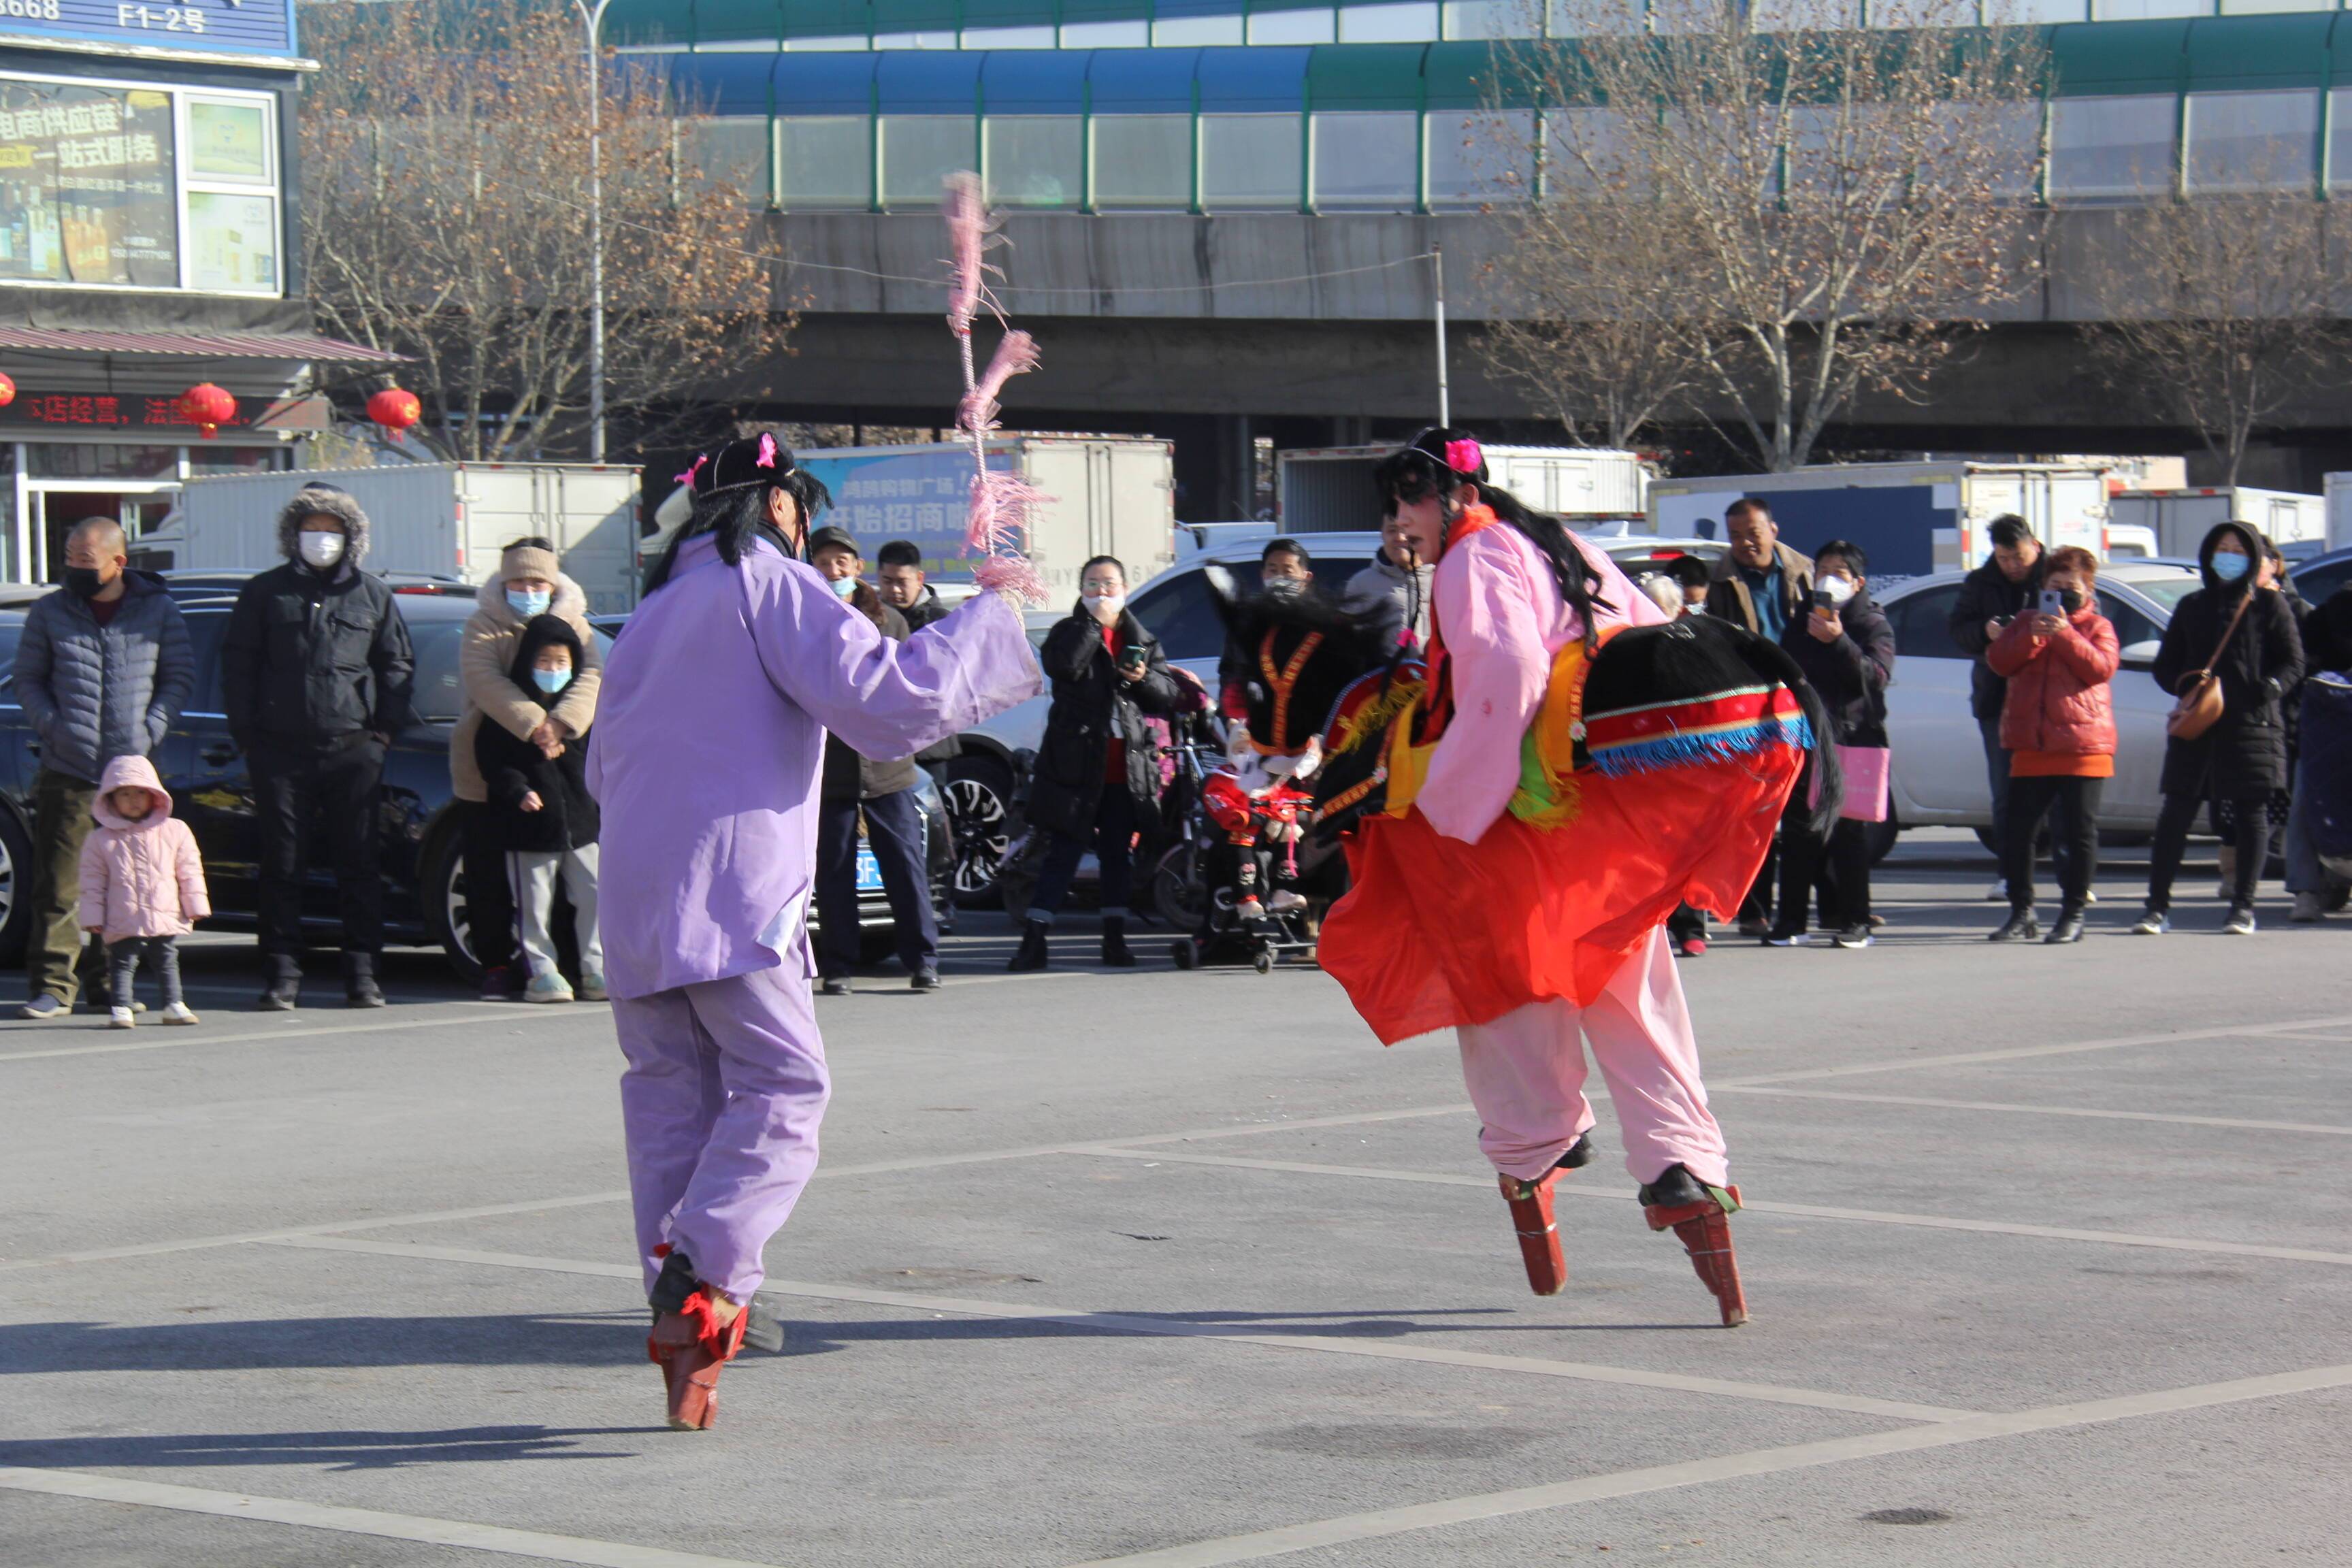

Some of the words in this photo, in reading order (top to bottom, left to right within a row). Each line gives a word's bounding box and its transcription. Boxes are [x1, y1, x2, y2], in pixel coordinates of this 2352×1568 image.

[117, 3, 206, 33] F1-2号
[33, 133, 158, 169] 一站式服务
